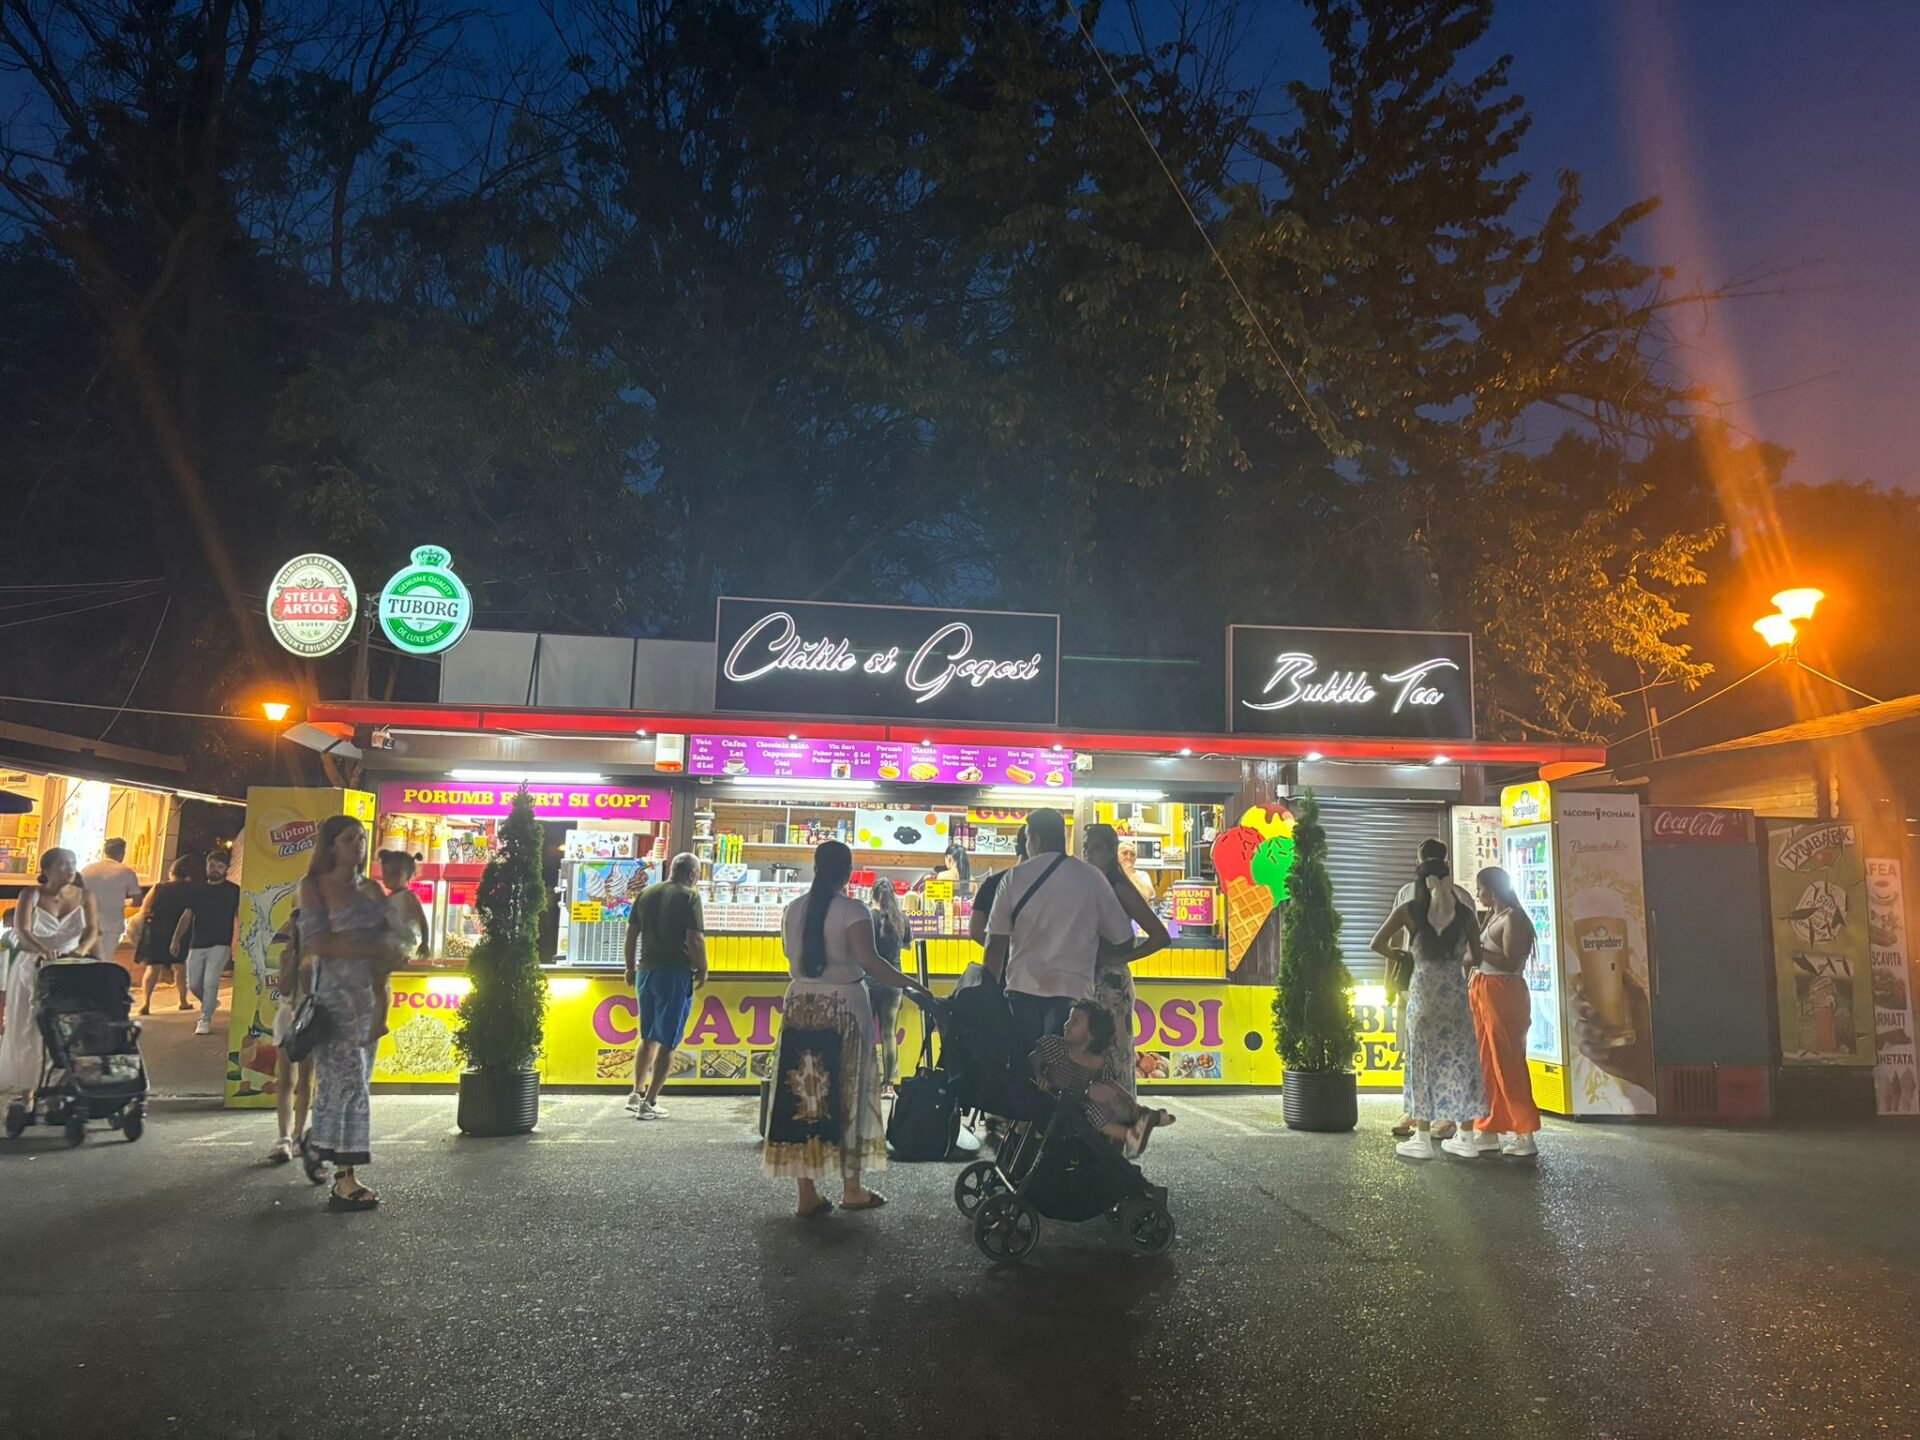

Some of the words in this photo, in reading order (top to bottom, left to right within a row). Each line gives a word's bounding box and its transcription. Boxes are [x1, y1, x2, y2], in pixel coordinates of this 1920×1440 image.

[398, 575, 427, 593] GENUINE
[428, 575, 454, 596] QUALITY
[283, 592, 338, 603] STELLA
[283, 603, 338, 615] ARTOIS
[388, 598, 459, 618] TUBORG
[406, 634, 425, 643] LUXE
[425, 629, 445, 641] BEER
[1242, 652, 1377, 710] Bubble
[1380, 657, 1460, 714] Tea
[721, 739, 748, 748] Cafea
[729, 749, 744, 758] Lei
[403, 788, 495, 805] PORUMB
[499, 790, 564, 807] FRT
[568, 792, 590, 807] SI
[594, 793, 651, 808] COPT
[272, 824, 314, 841] Lipton
[1654, 811, 1726, 836] Coca-Cola
[1784, 828, 1852, 865] TYMBARK
